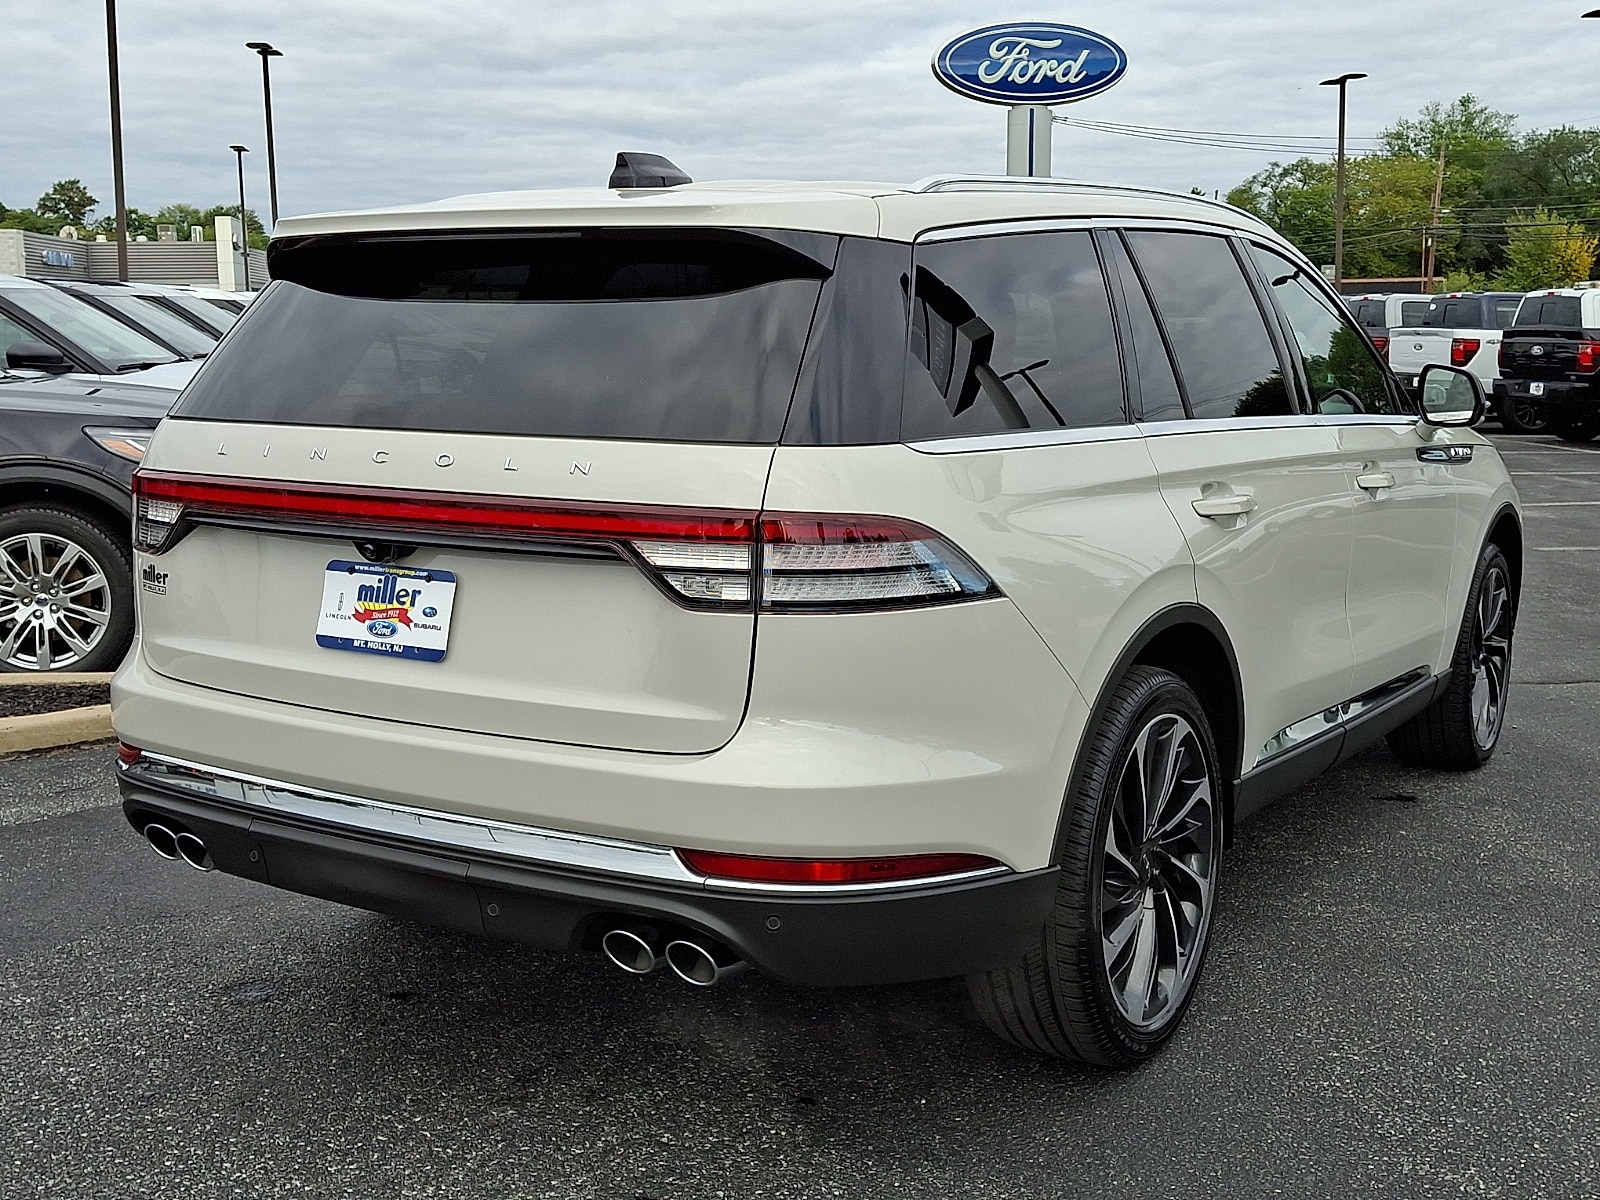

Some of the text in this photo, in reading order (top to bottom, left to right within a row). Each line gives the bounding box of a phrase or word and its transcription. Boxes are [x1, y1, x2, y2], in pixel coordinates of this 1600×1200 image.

[978, 36, 1091, 84] Ford
[217, 443, 592, 475] LINCOLN
[142, 563, 169, 585] miller
[357, 574, 422, 608] miller
[325, 612, 352, 621] LINCOLN
[371, 611, 387, 619] Since
[372, 621, 393, 636] Ford
[413, 623, 442, 631] SUBARU
[353, 639, 404, 653] MT. HOLLY, NJ
